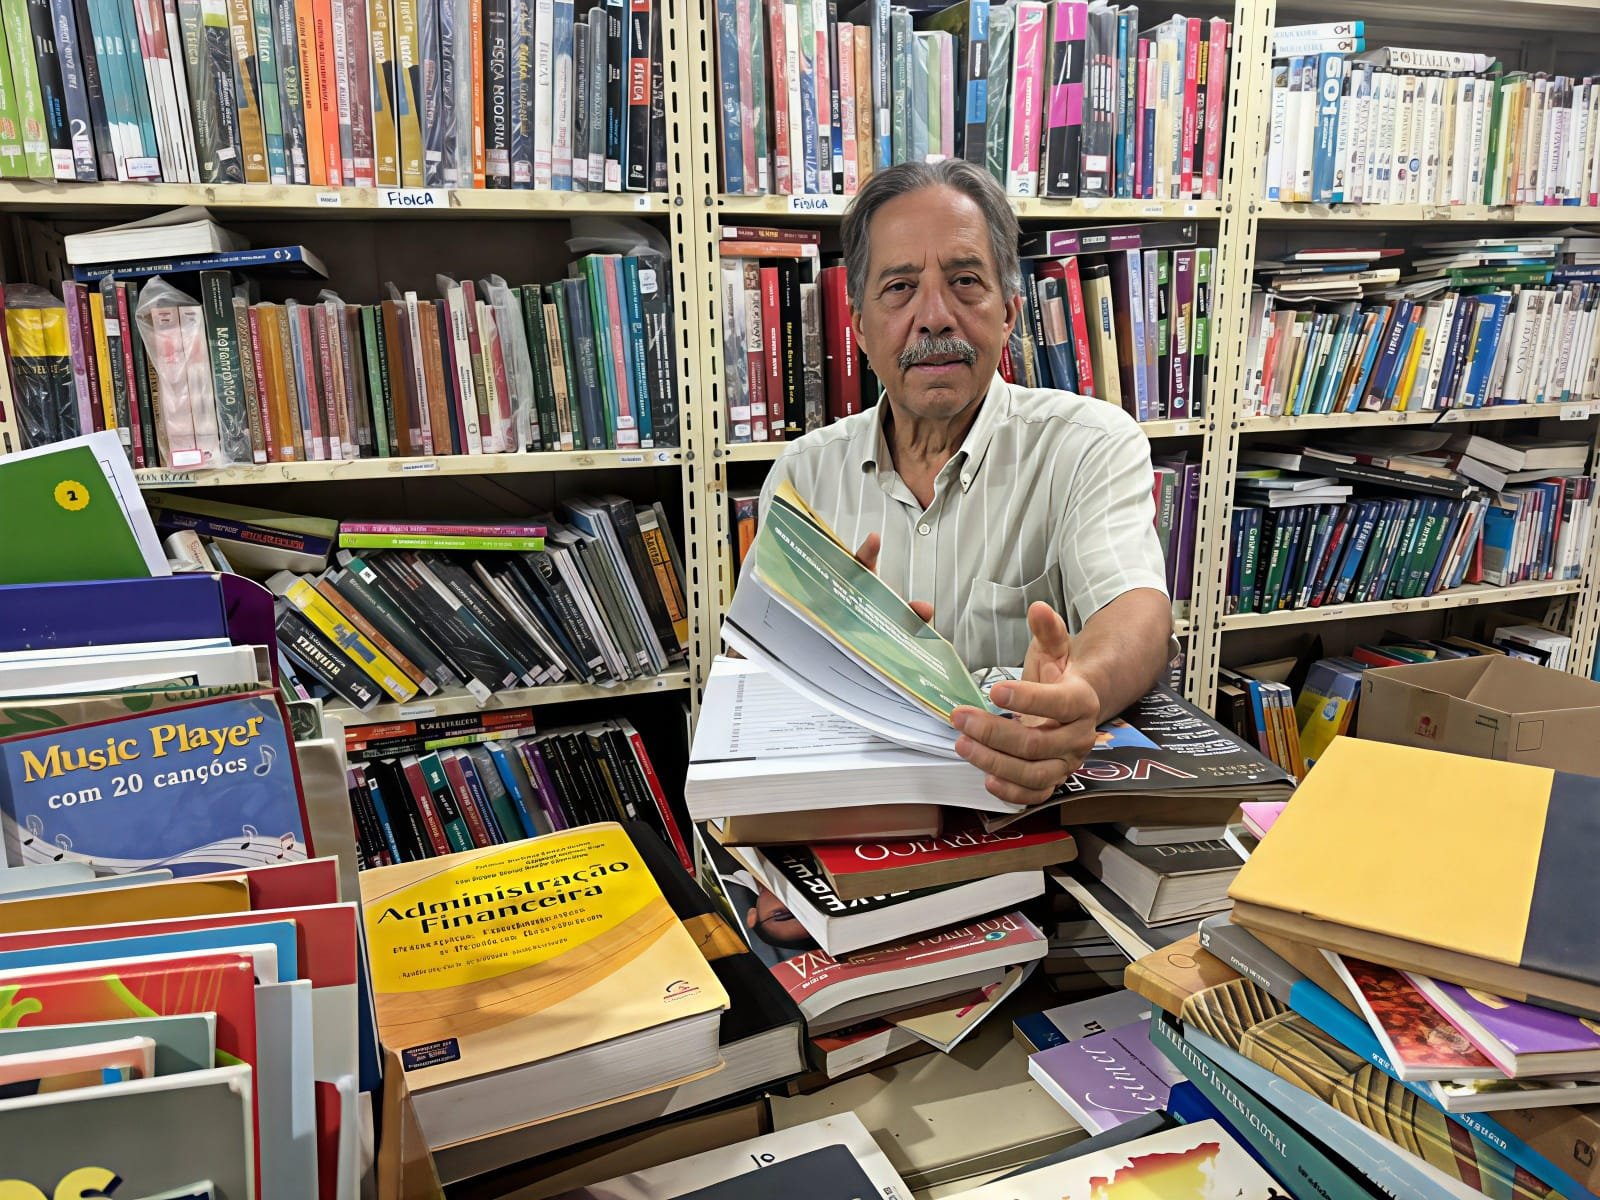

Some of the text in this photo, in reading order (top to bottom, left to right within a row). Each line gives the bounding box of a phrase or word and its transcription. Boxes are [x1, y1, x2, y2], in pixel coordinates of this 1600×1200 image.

[20, 715, 266, 783] Music Player
[48, 785, 103, 810] com
[111, 773, 144, 798] 20
[377, 861, 630, 925] Administração
[422, 883, 604, 934] Financeira
